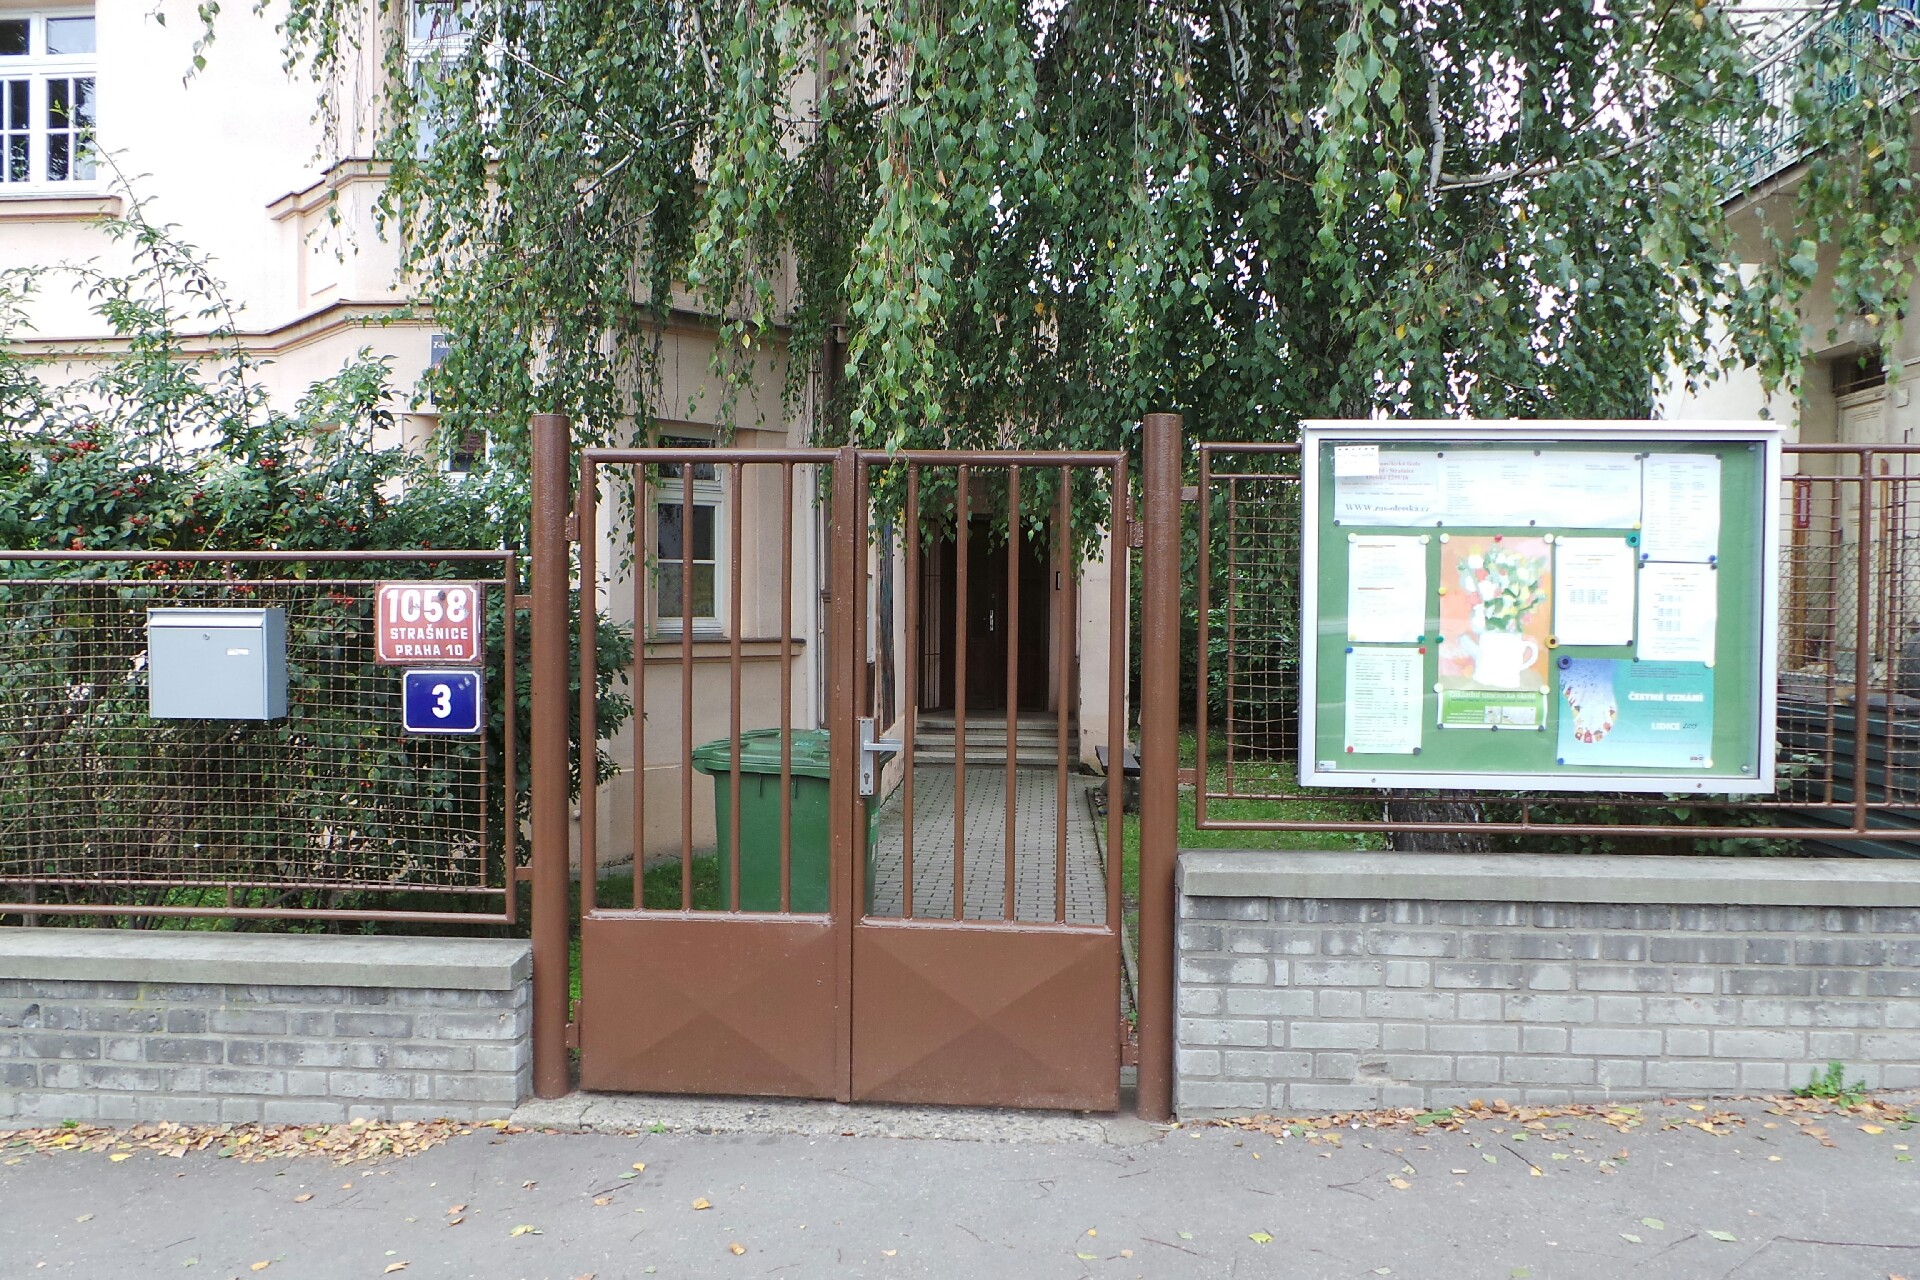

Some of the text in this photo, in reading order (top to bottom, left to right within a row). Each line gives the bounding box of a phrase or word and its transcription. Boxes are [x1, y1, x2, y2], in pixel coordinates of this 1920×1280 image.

[387, 589, 467, 623] 1058
[391, 624, 468, 640] STRAŠNICE
[396, 645, 463, 656] PRAHA 10
[432, 684, 451, 718] 3
[1651, 722, 1680, 730] LIDICE
